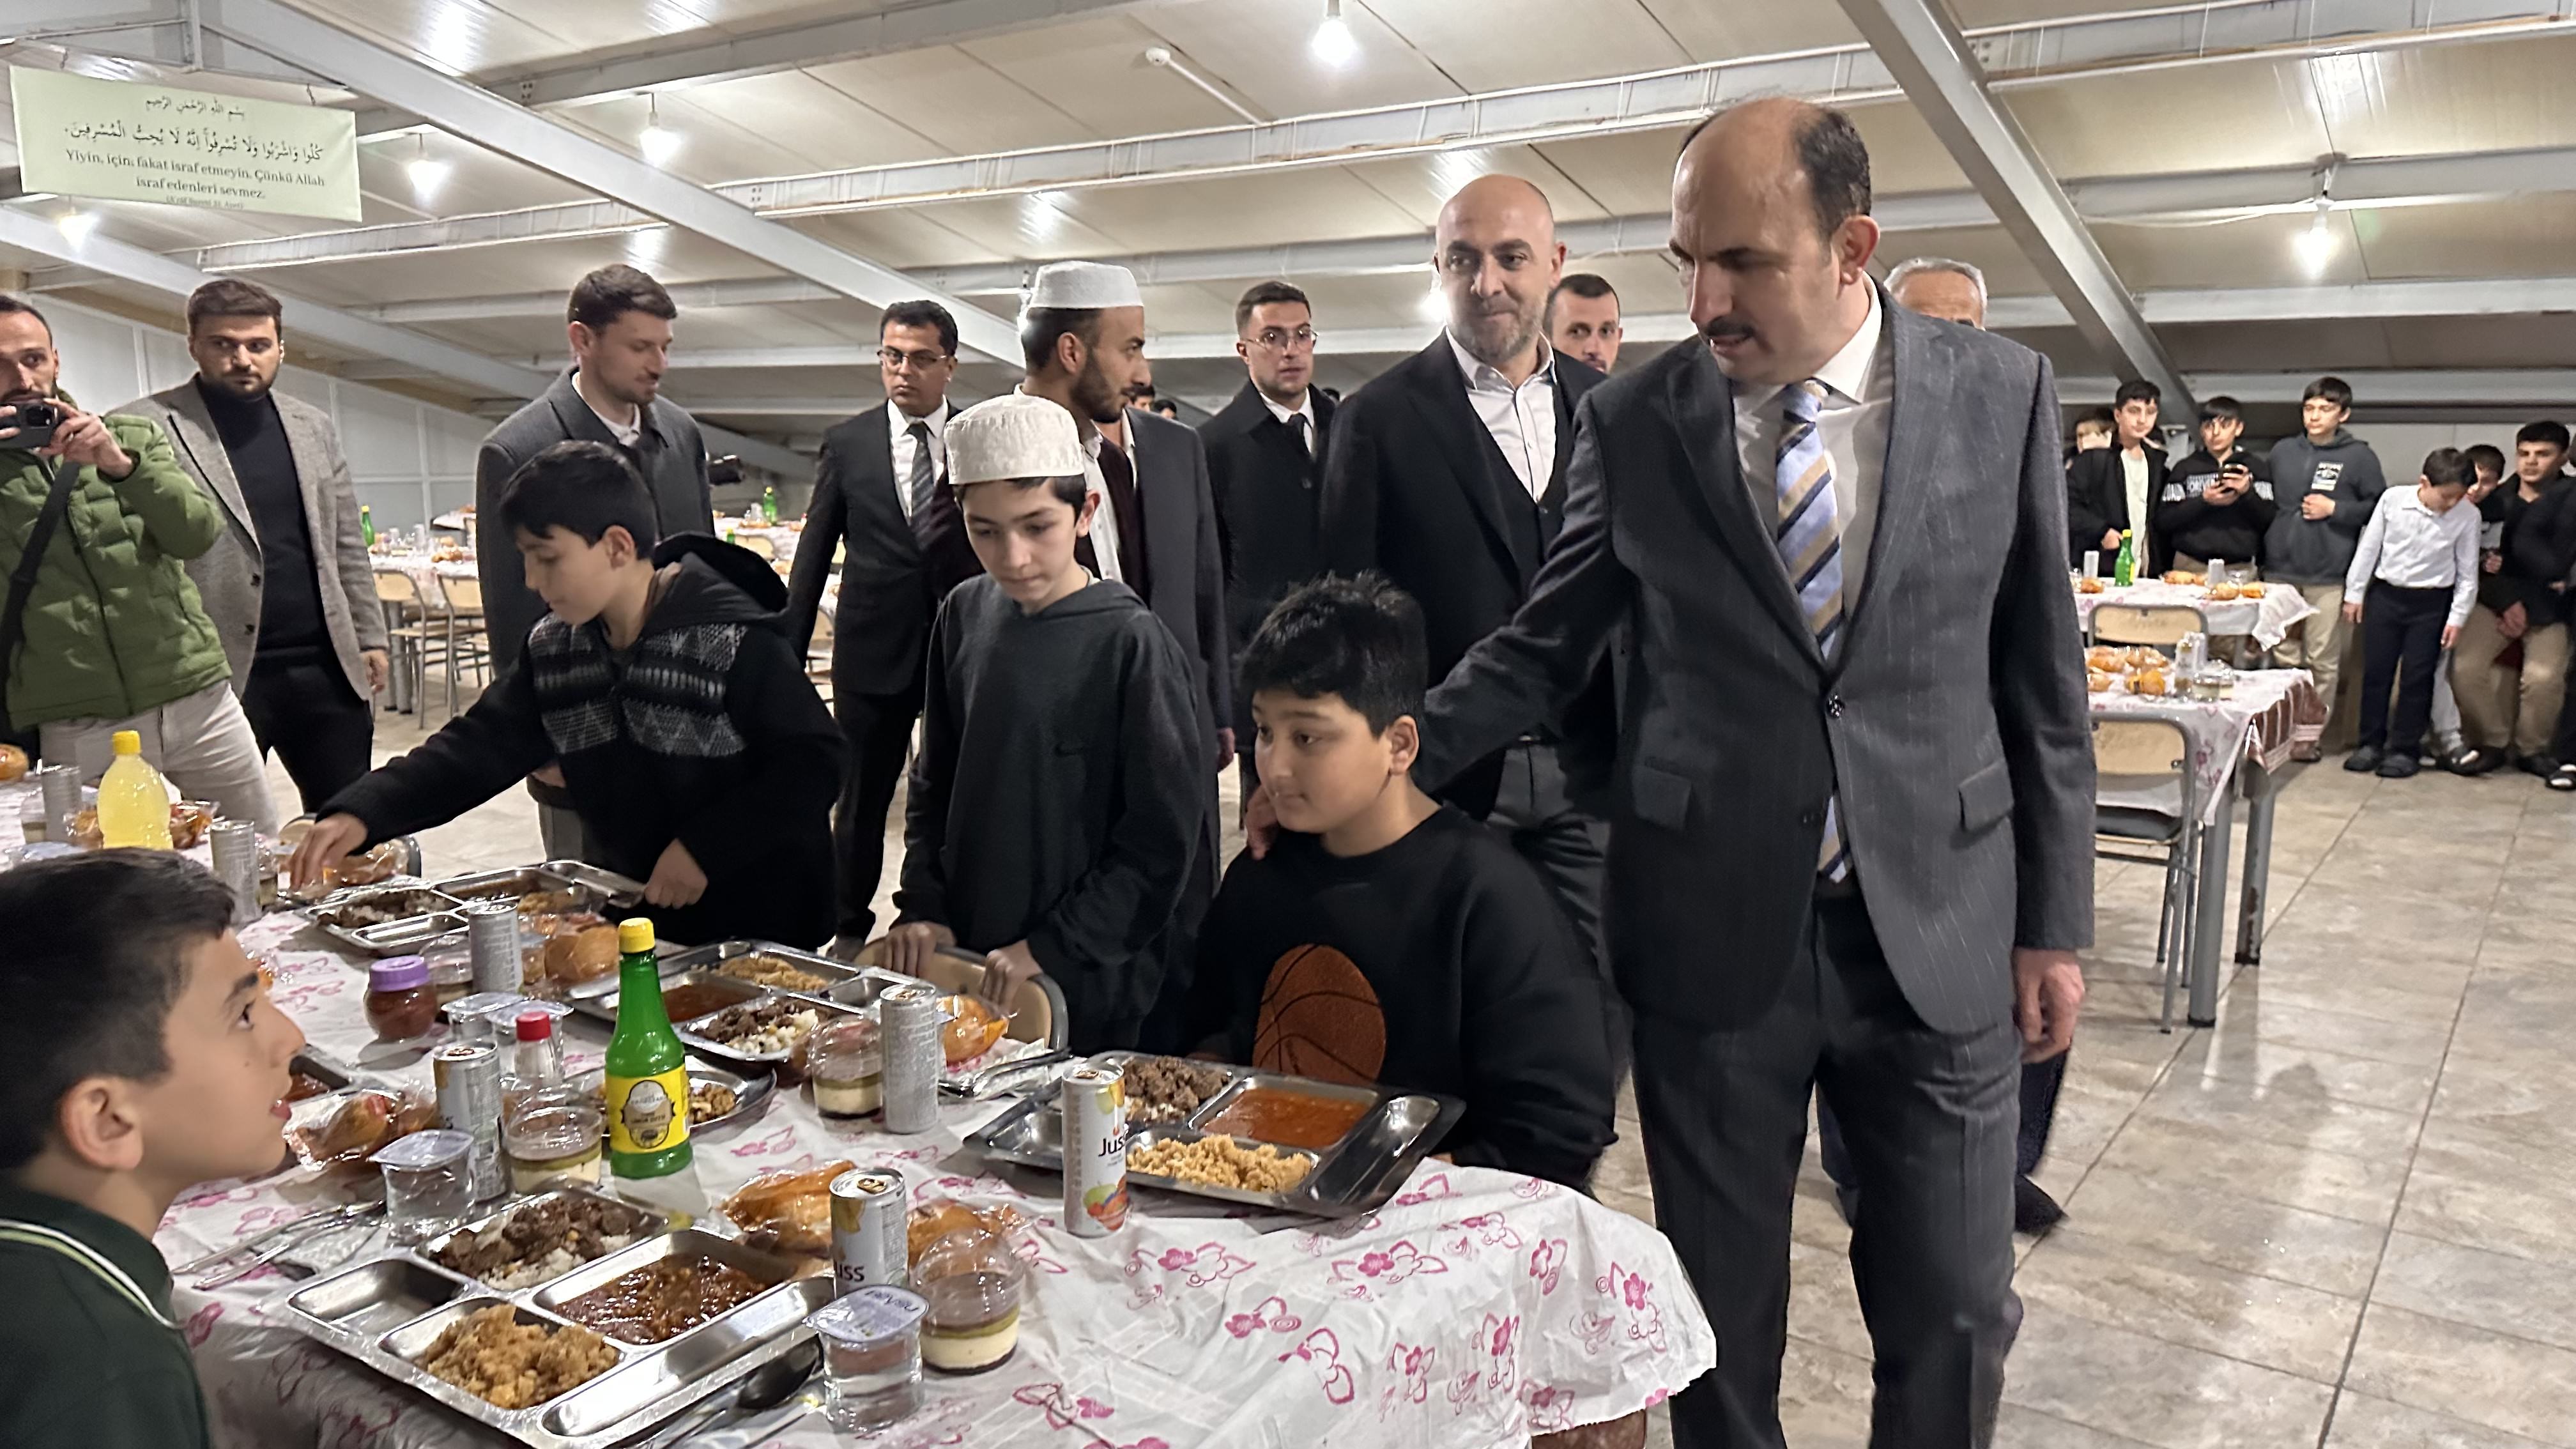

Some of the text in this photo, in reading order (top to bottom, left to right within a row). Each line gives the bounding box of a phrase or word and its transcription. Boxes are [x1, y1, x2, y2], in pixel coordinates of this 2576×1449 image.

[137, 156, 169, 171] fakat
[171, 159, 199, 174] israf
[255, 169, 293, 184] Çünkü
[295, 172, 326, 187] Allah
[136, 176, 266, 199] israf edenleri sevmez.
